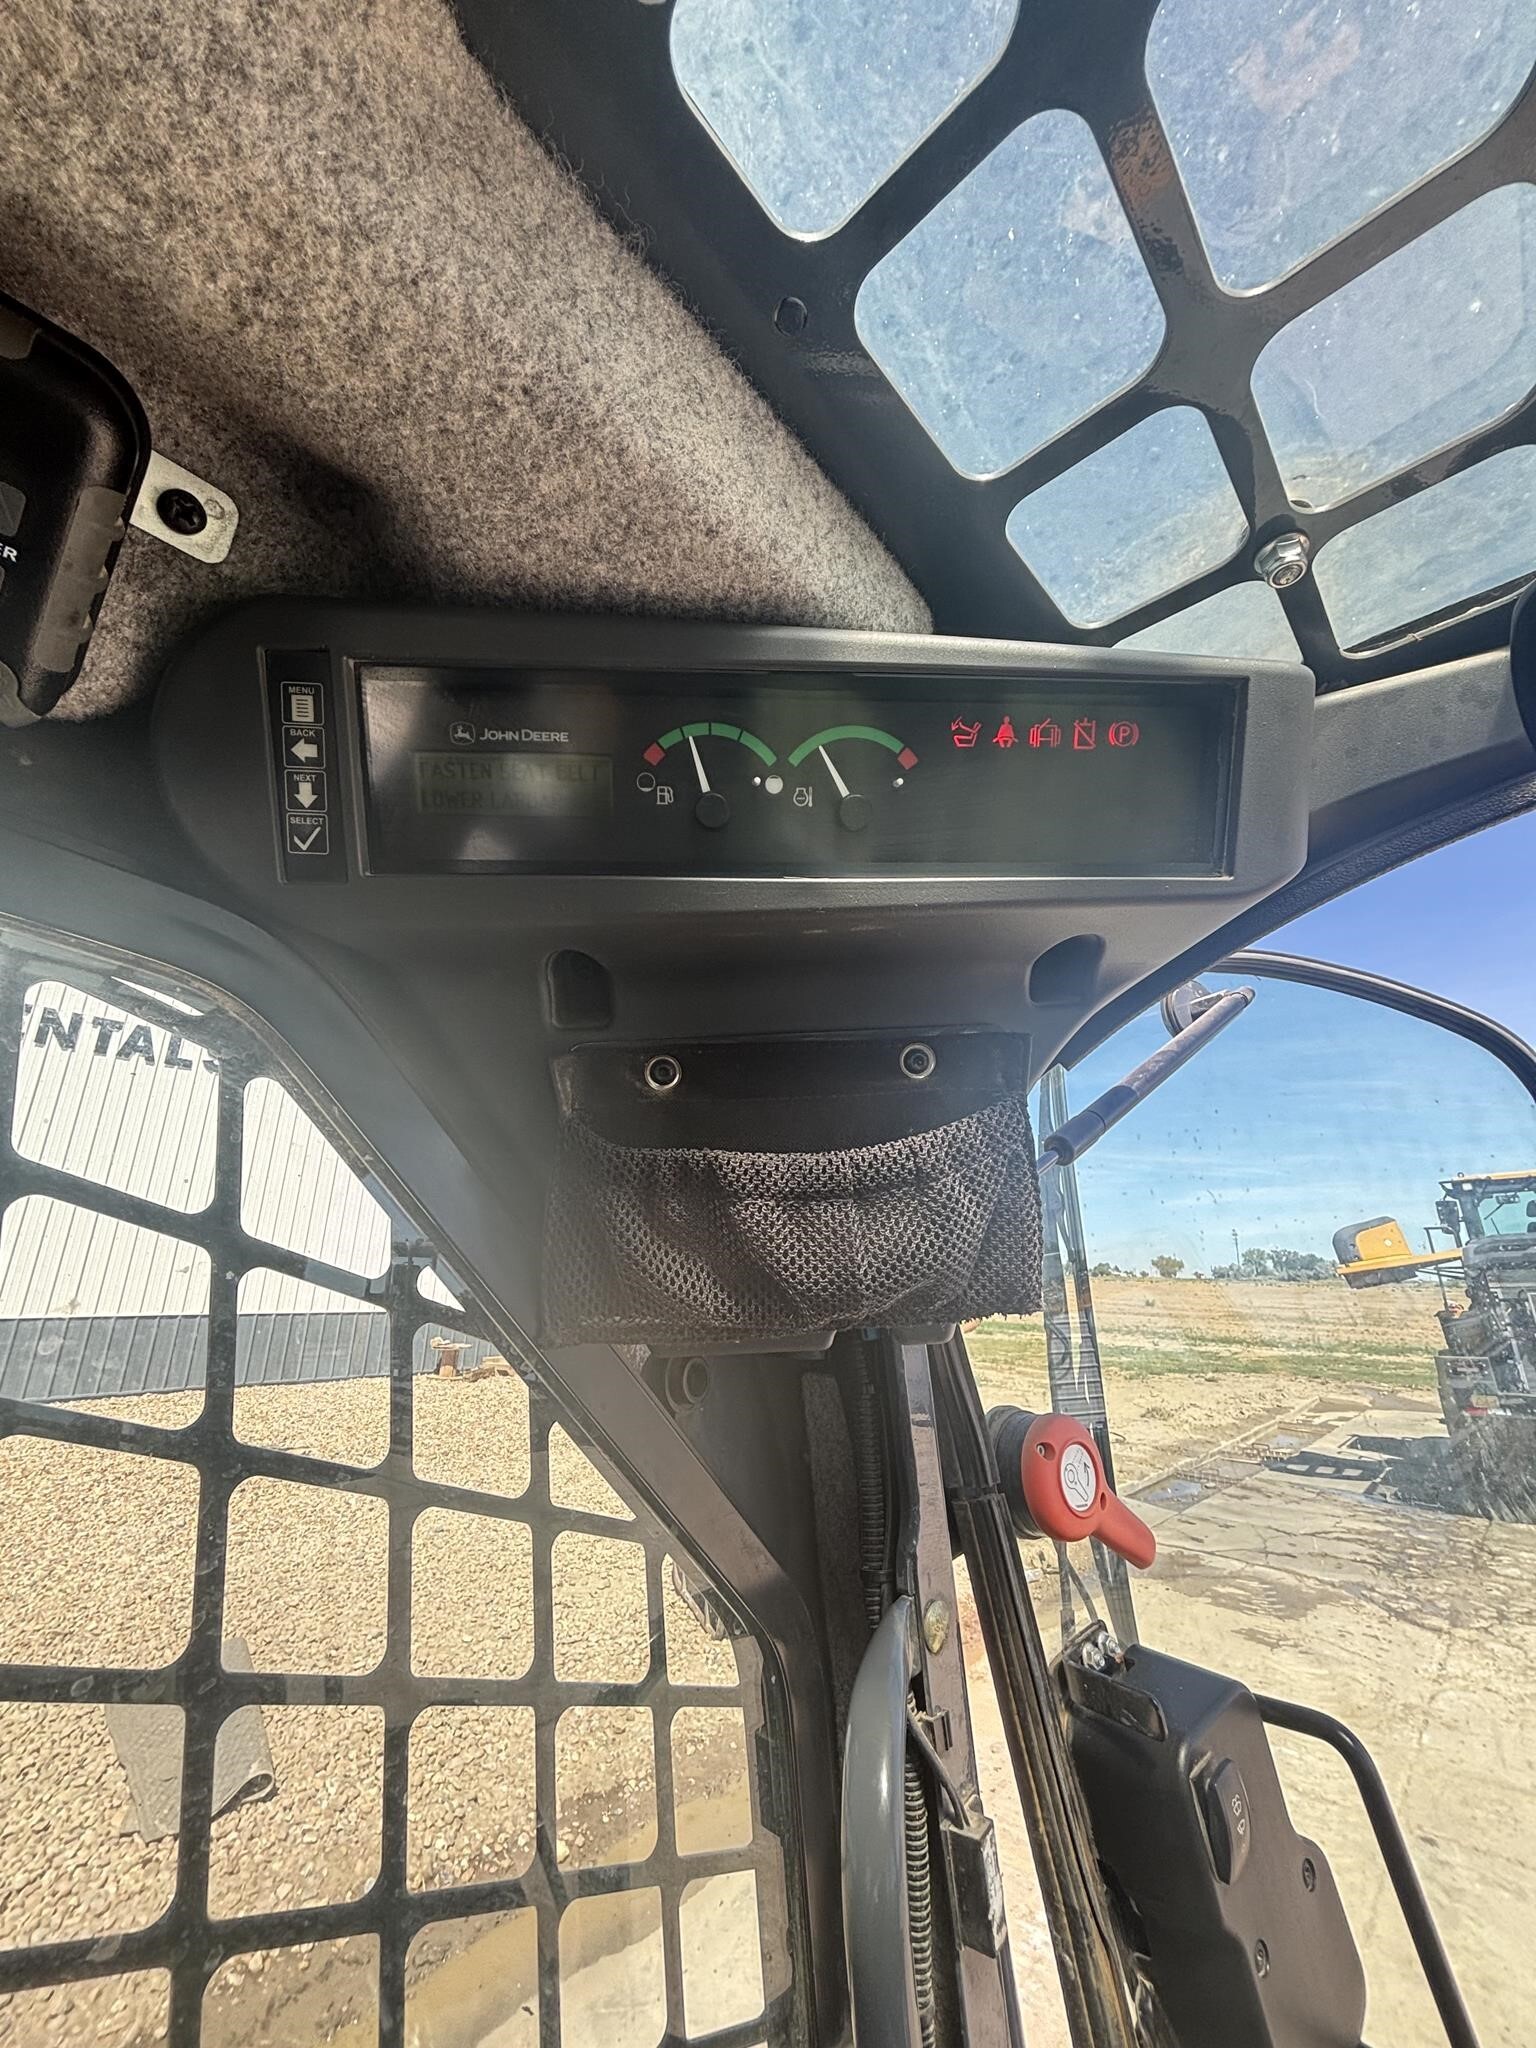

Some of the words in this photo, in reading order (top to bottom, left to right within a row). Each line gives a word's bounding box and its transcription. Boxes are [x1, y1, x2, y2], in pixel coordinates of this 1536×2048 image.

[288, 686, 315, 695] MENU
[289, 728, 316, 737] BACK
[480, 728, 519, 741] JOHN
[521, 729, 569, 742] DEERE
[293, 773, 317, 782] NEXT
[289, 816, 325, 825] SELECT
[21, 1003, 220, 1076] NTAL
